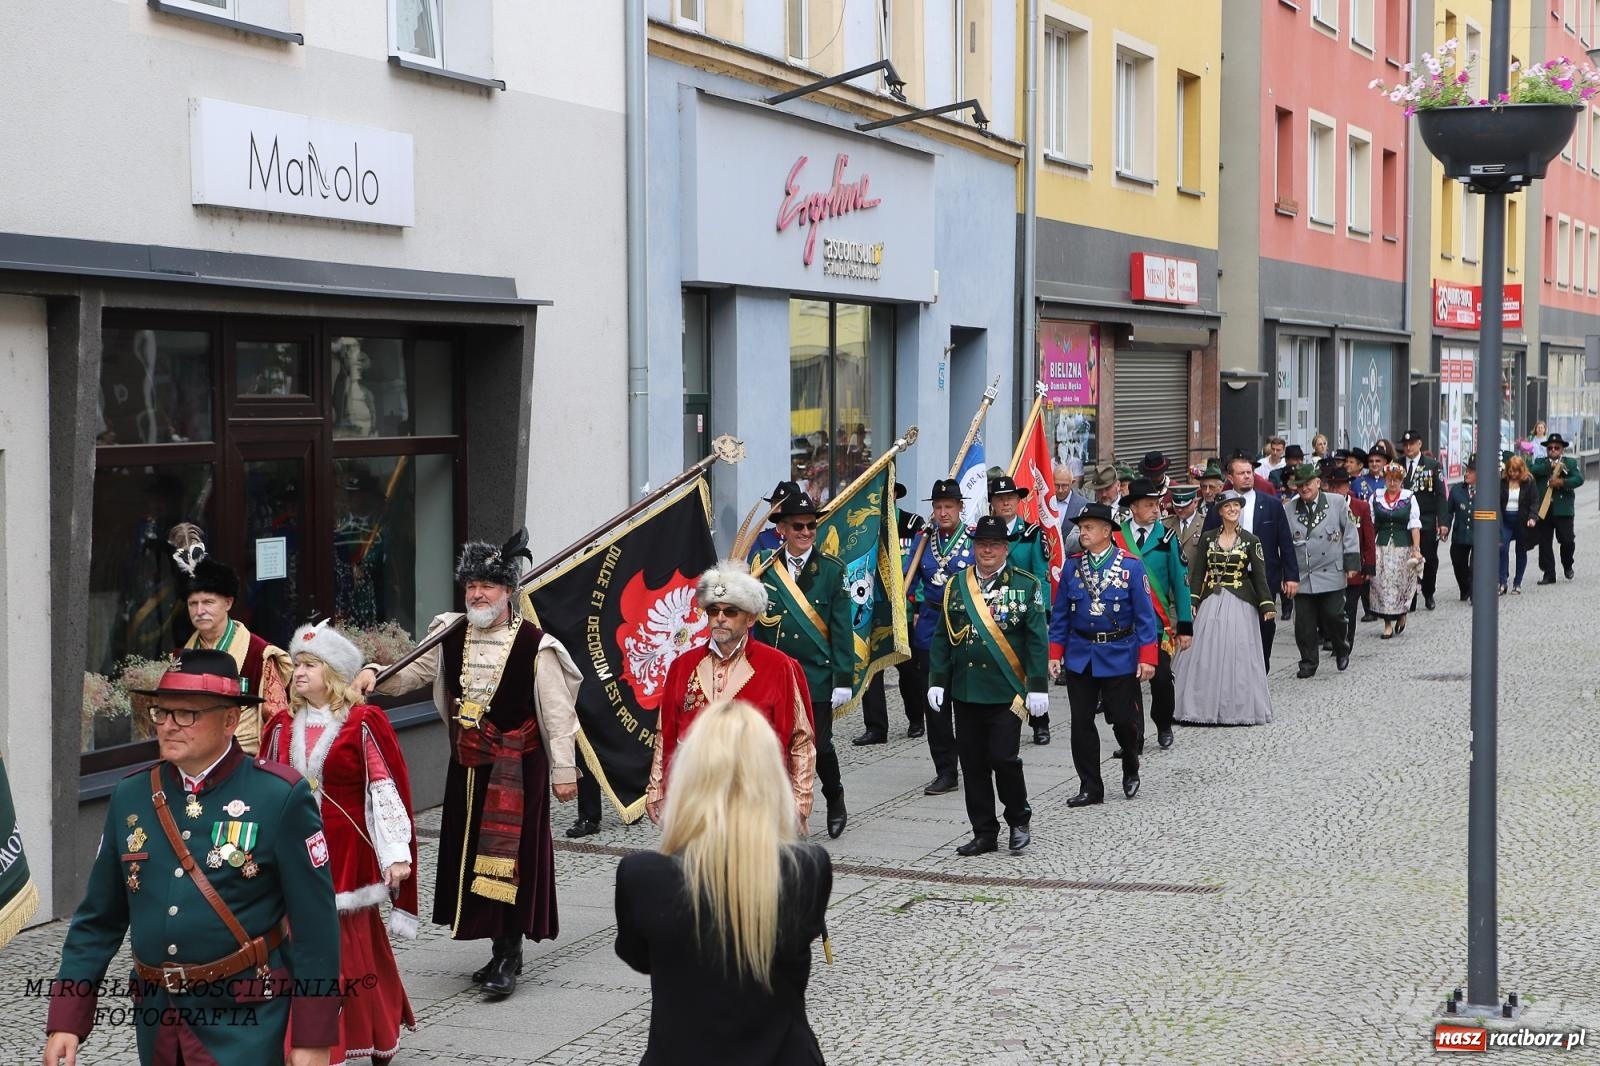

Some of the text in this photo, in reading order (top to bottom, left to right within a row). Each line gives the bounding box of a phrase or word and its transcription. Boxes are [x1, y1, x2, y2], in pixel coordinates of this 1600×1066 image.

[1050, 362, 1082, 378] BIELIZNA
[597, 545, 622, 589] DULCE
[591, 589, 605, 609] ET
[587, 616, 613, 681] DECORUM
[605, 682, 622, 707] EST
[616, 705, 639, 733] PRO
